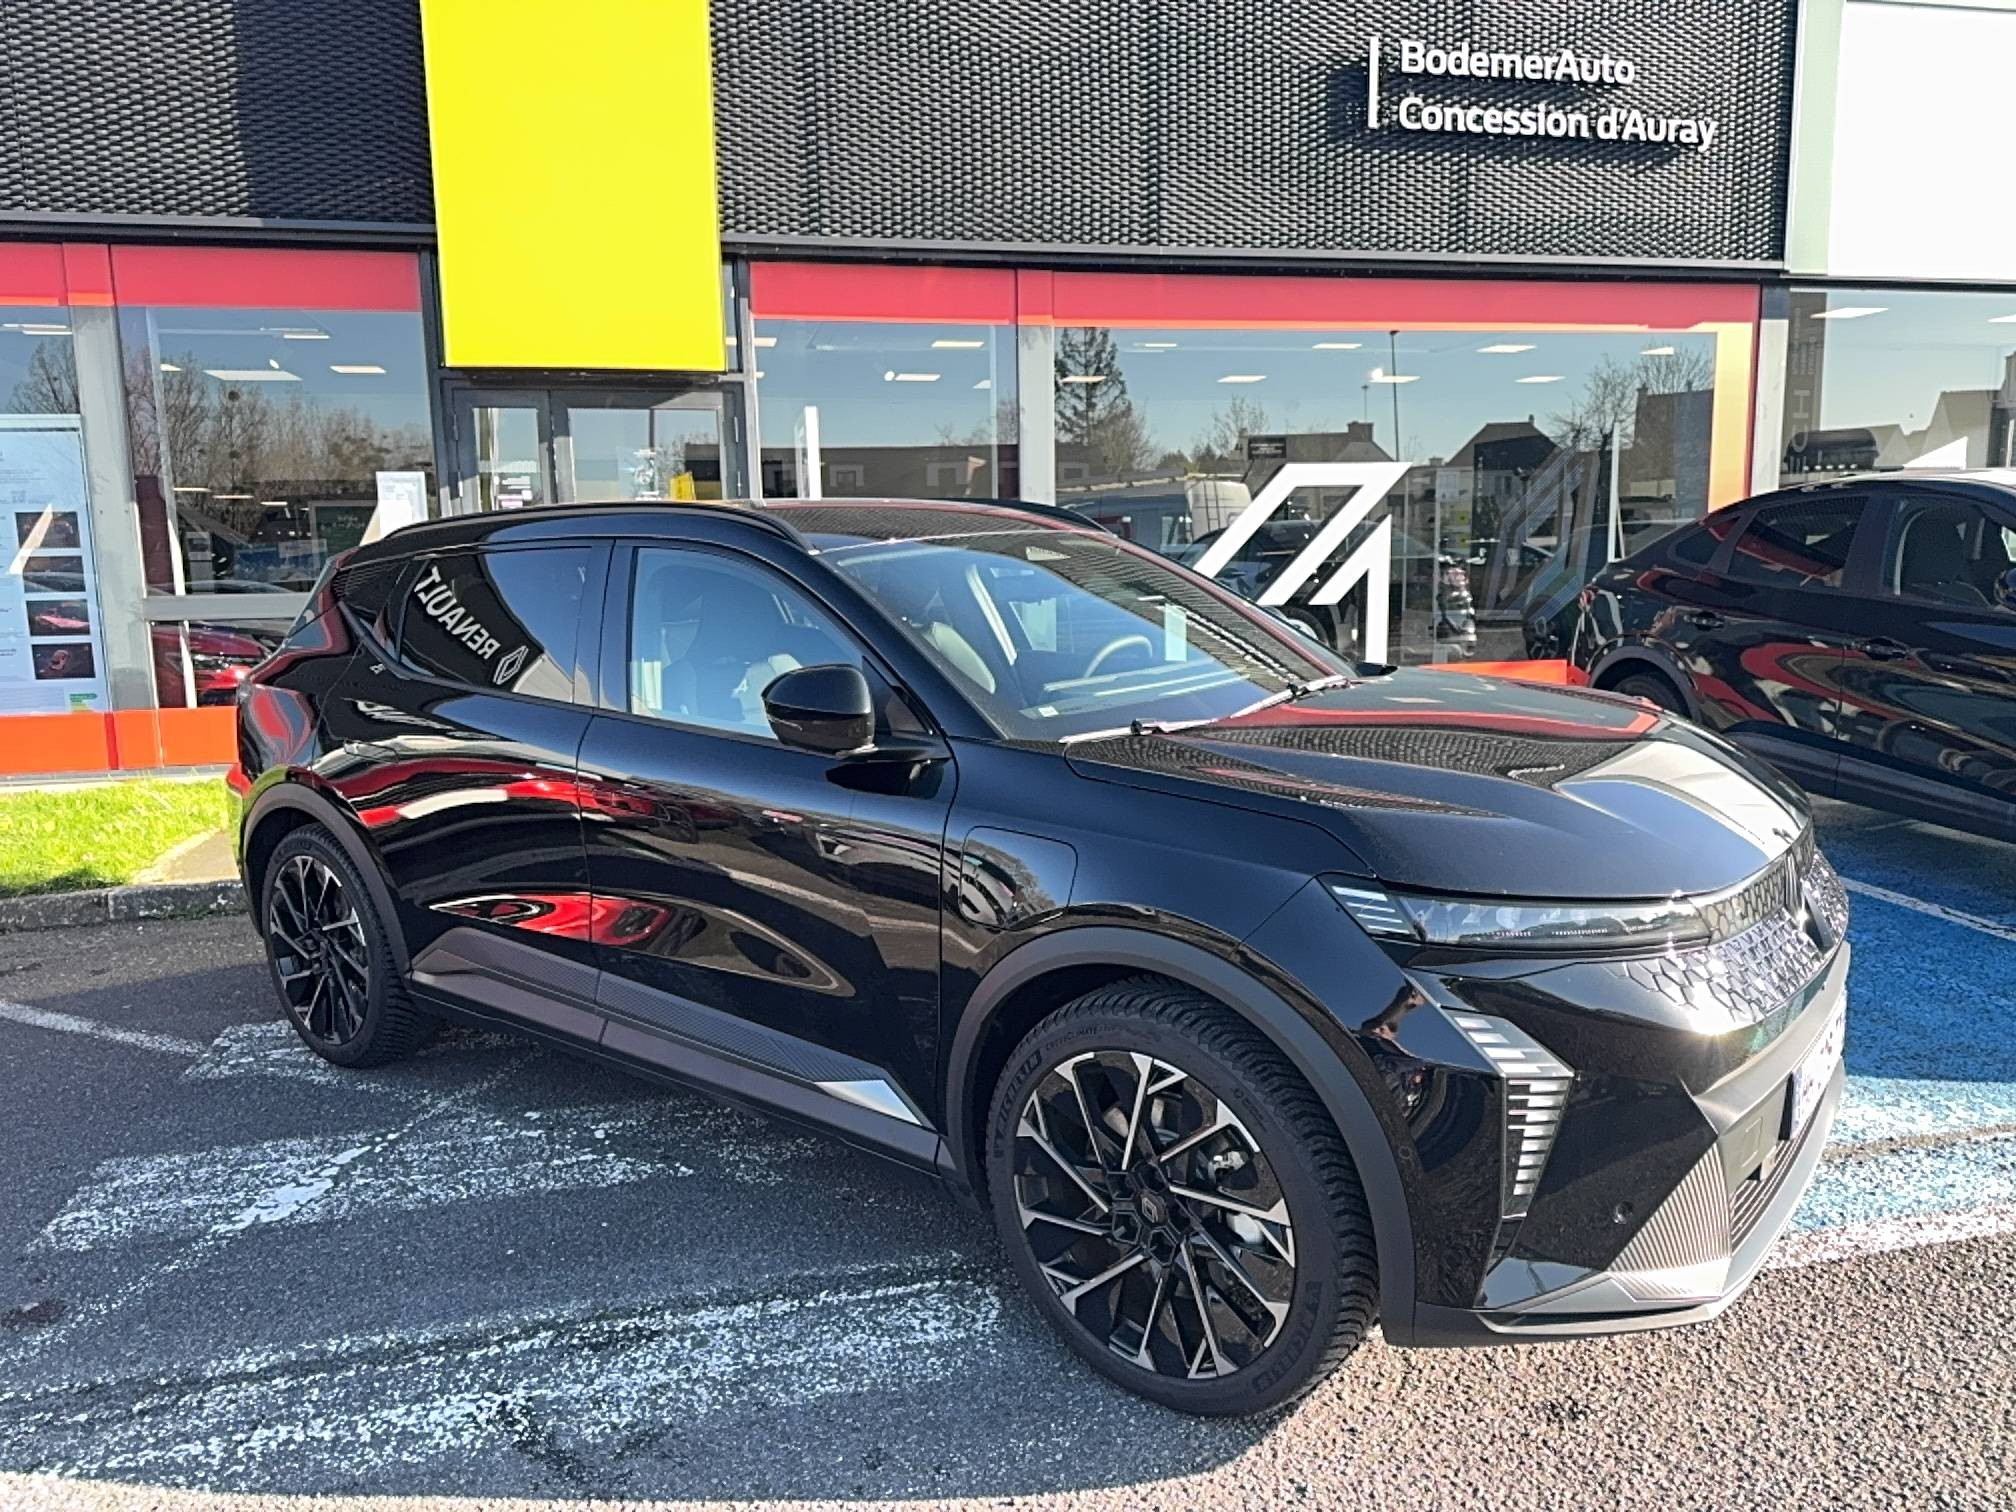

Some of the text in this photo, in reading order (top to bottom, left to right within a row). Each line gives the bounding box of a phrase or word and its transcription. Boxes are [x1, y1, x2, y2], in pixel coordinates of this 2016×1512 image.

[1400, 39, 1635, 84] BodemerAuto
[1399, 96, 1716, 151] Concession d'Auray
